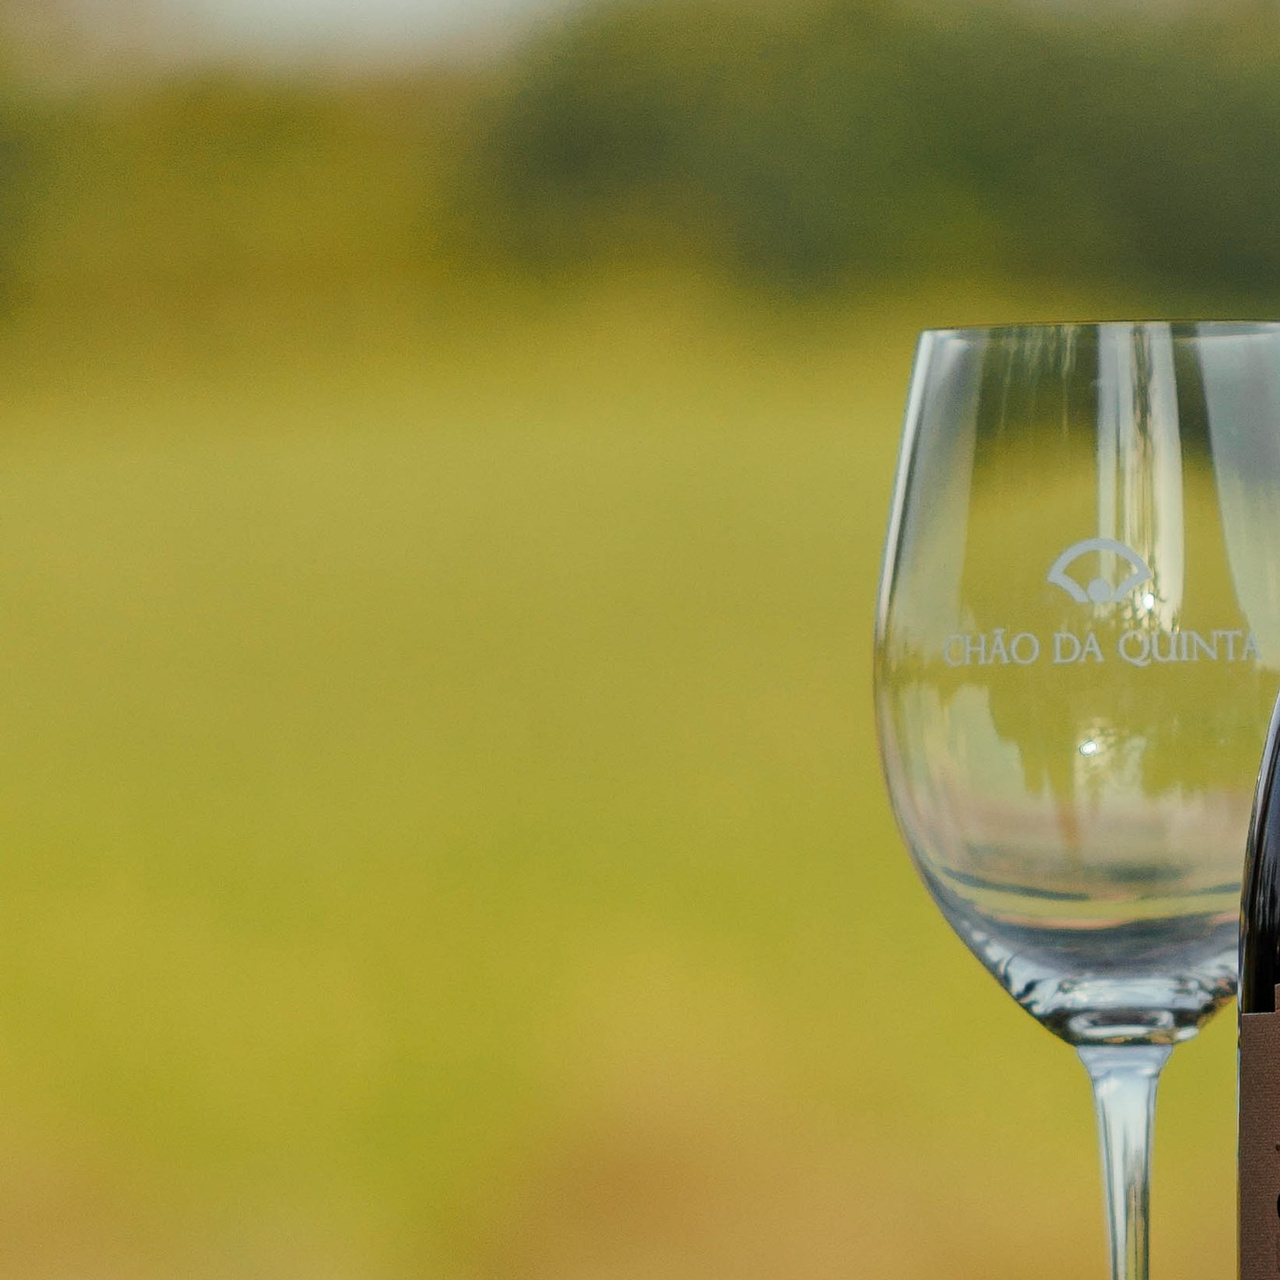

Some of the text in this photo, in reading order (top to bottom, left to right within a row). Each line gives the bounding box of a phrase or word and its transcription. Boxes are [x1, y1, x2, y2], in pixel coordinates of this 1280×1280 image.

[942, 628, 1264, 668] CHÃO DA QUINTA
